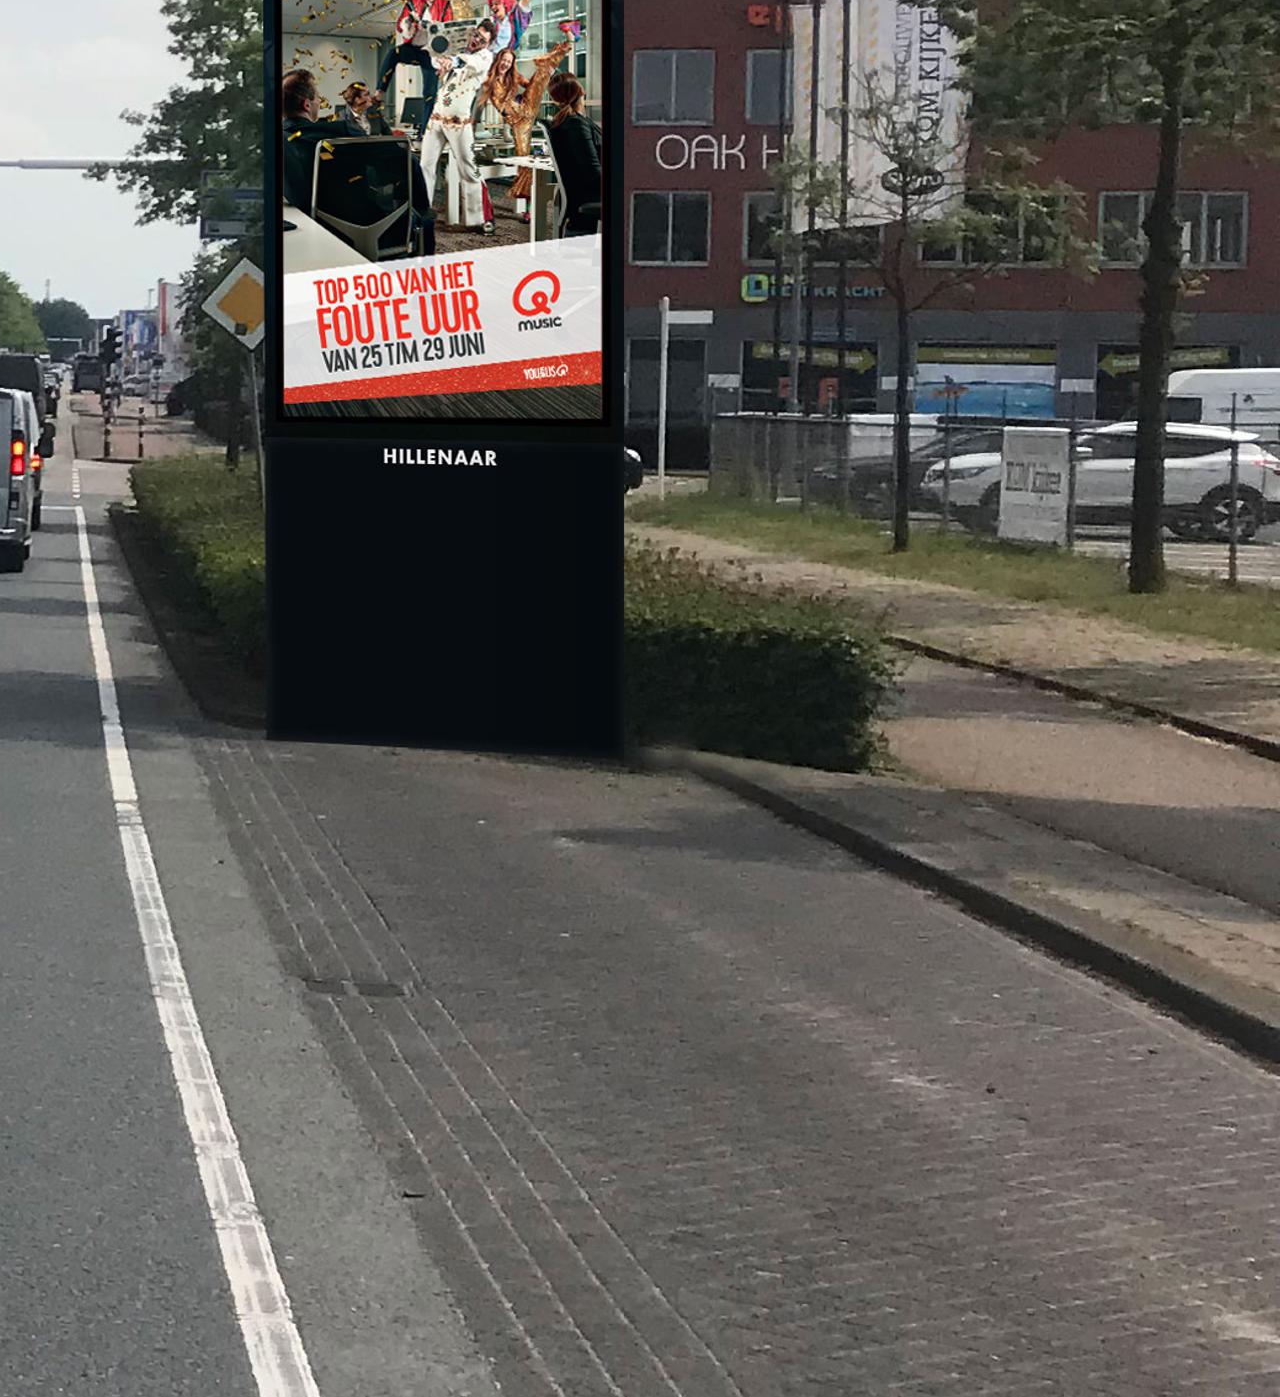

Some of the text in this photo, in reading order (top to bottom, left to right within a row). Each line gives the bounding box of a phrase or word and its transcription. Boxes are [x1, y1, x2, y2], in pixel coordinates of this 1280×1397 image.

[655, 134, 745, 170] OAK
[313, 261, 474, 305] TOP 500 VAN HET
[316, 289, 482, 348] FOUTE UUR
[322, 332, 485, 373] VAN 25 T/M 29 JUNI
[383, 448, 497, 466] HILLENAAR
